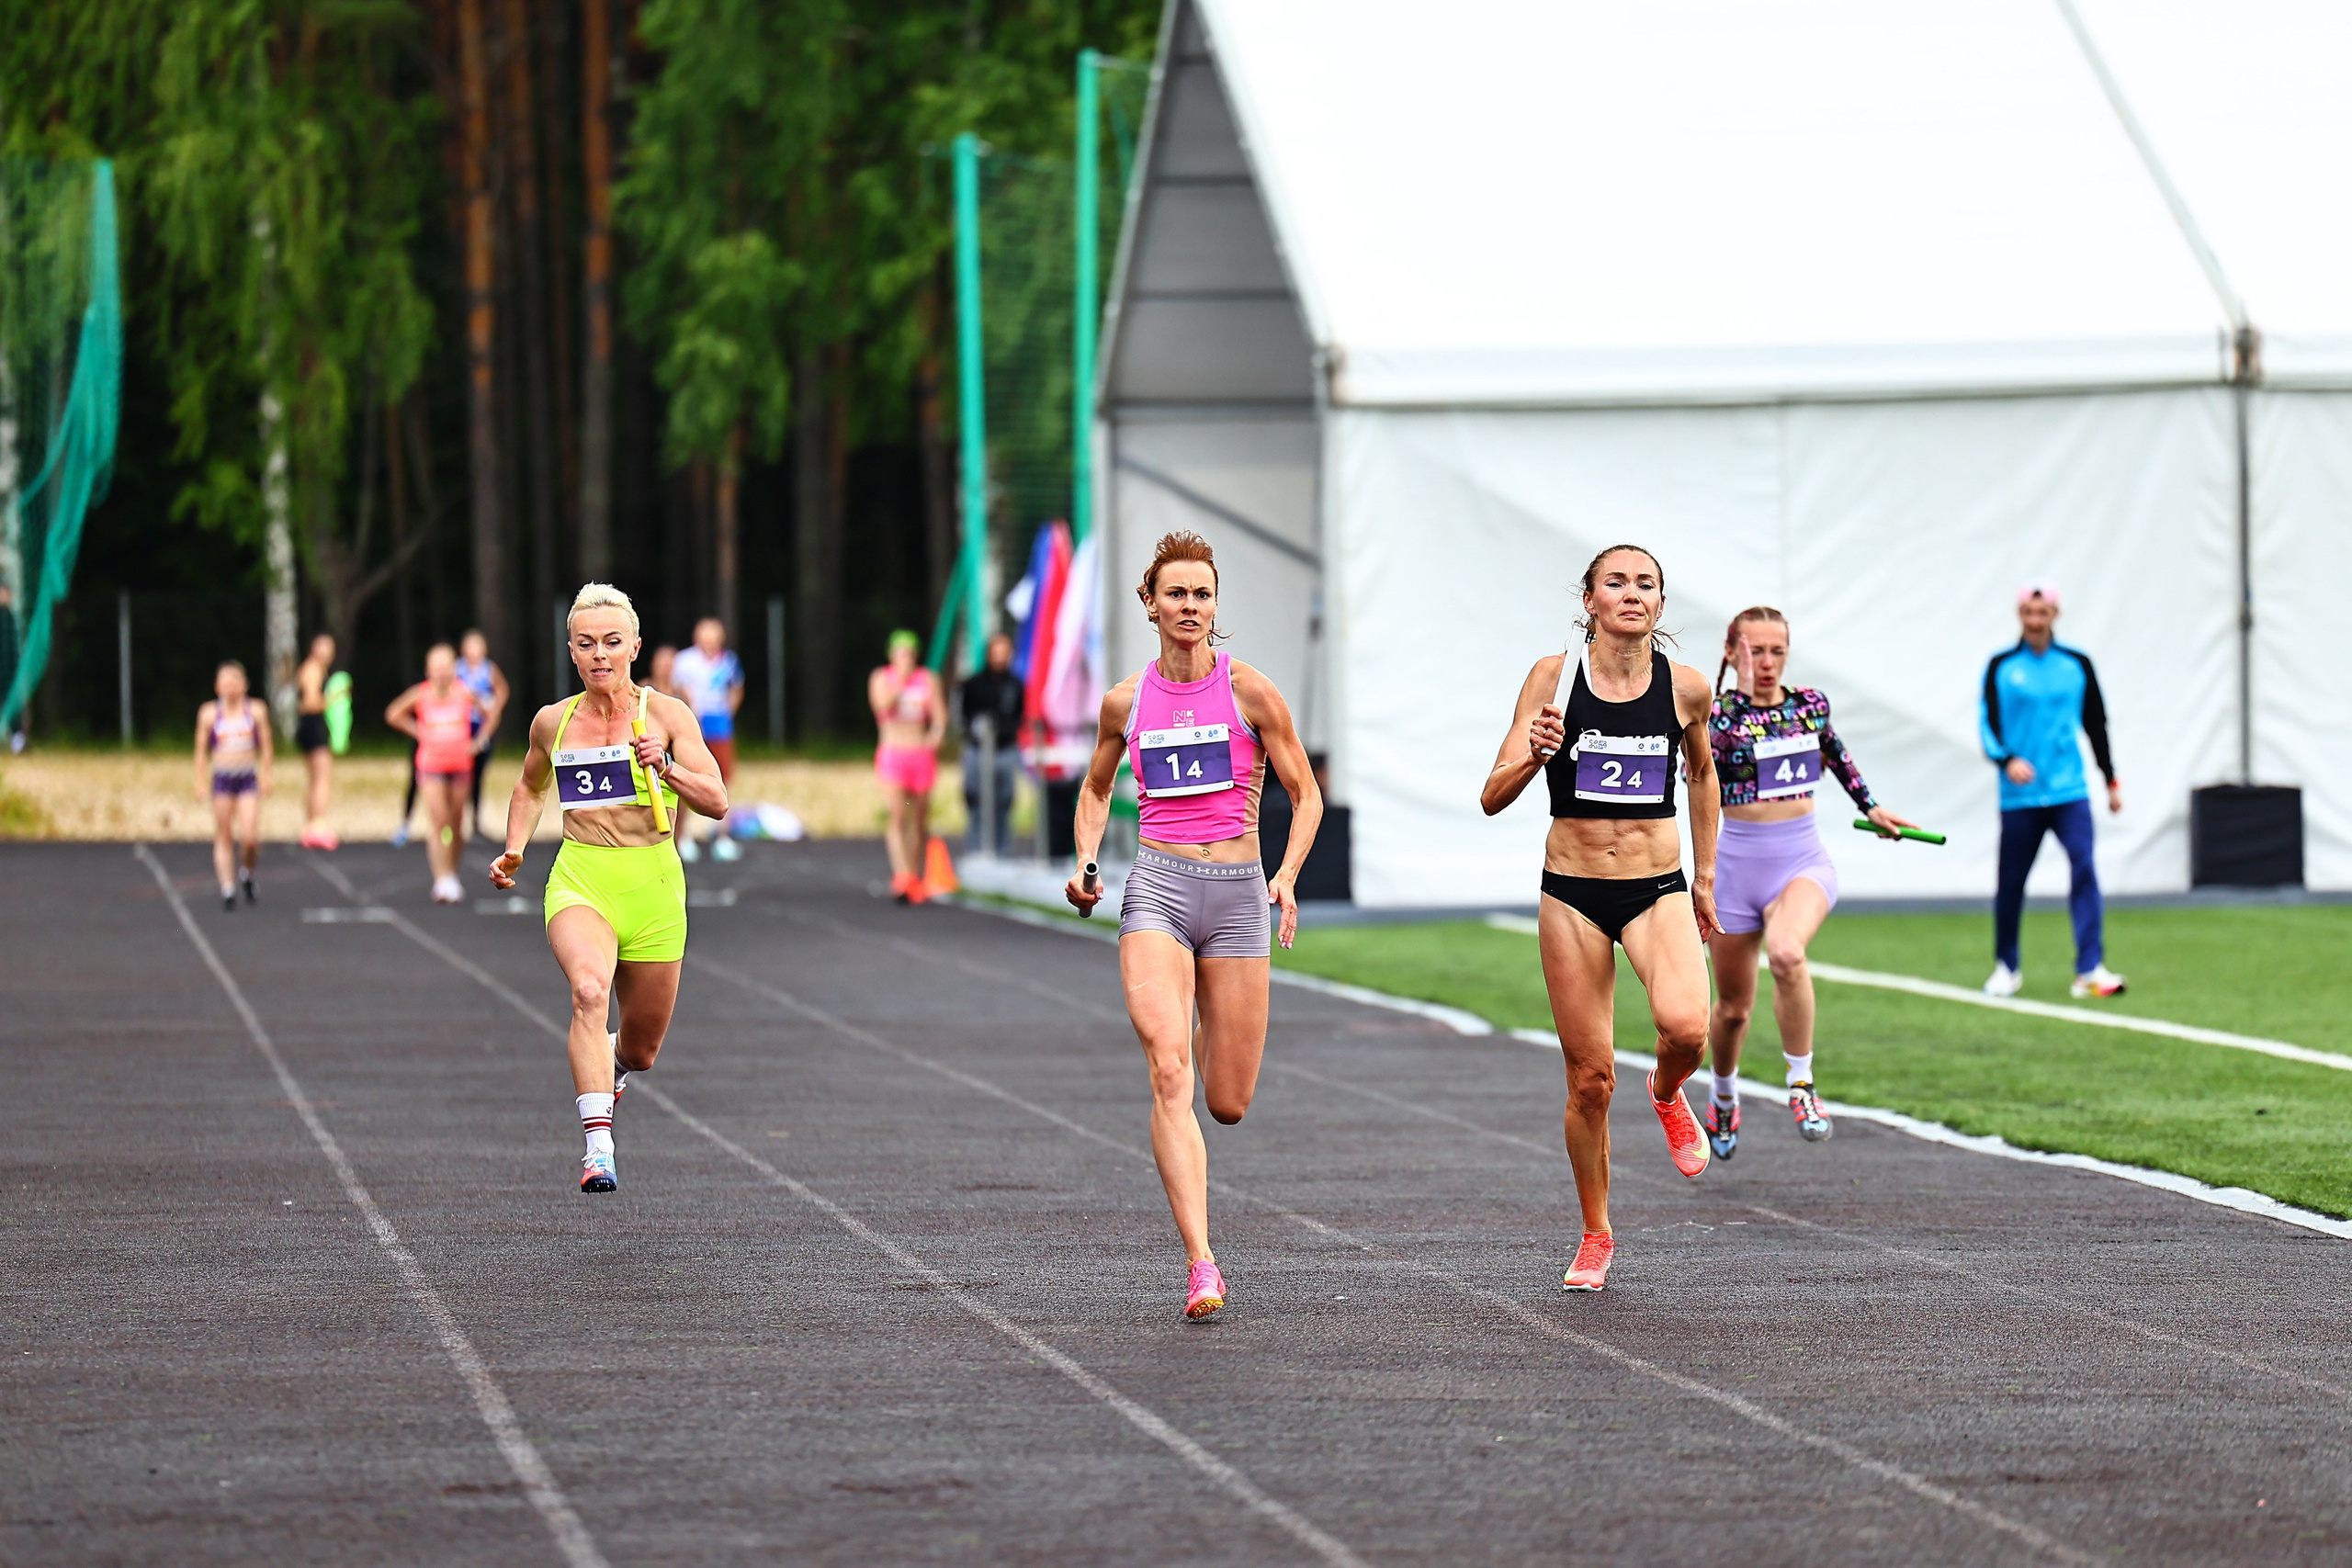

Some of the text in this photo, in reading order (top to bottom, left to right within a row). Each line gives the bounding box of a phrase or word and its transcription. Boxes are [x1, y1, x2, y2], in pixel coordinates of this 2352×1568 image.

[1166, 752, 1203, 781] 1 4
[1600, 761, 1643, 788] 2 4
[1775, 759, 1808, 783] 4 4
[575, 771, 613, 795] 3 4
[1147, 855, 1260, 875] ARMOUR ARMOUR
